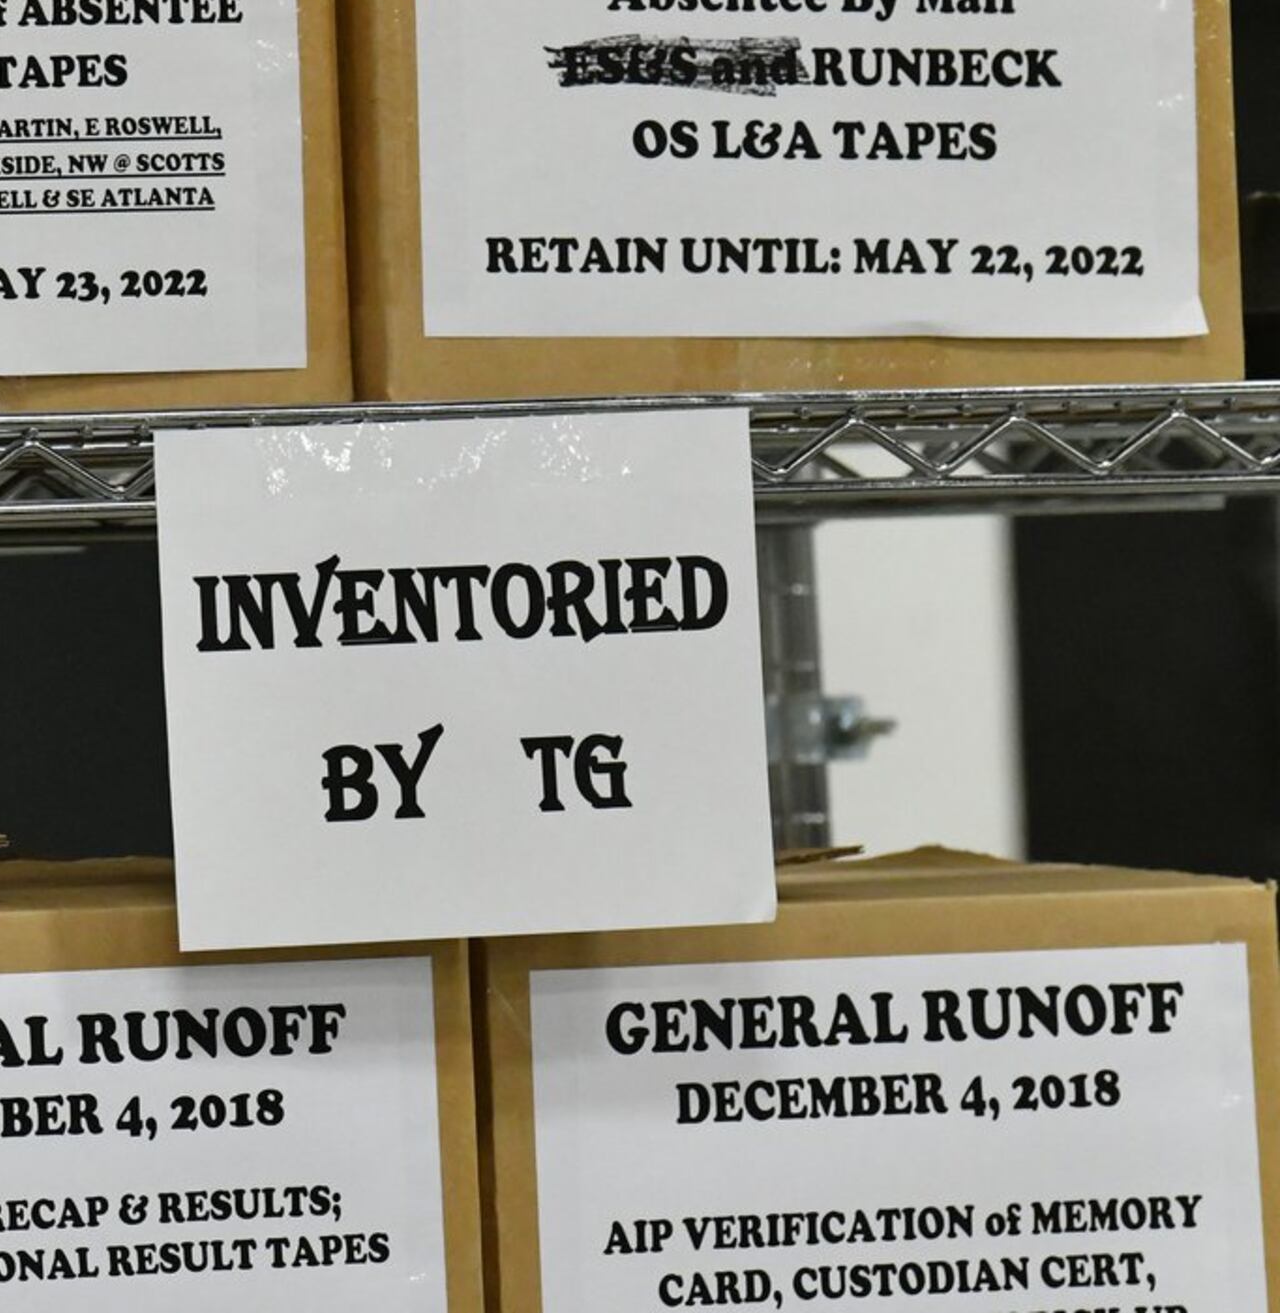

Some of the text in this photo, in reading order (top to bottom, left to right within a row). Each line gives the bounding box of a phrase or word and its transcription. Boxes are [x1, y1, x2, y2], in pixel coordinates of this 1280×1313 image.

[812, 47, 1062, 88] RUNBECK
[85, 118, 100, 136] E
[105, 115, 222, 137] ROSWELL,
[633, 120, 996, 160] OS L&A TAPES
[67, 154, 108, 174] NW
[113, 153, 131, 174] @
[135, 152, 226, 173] SCOTTS
[42, 189, 61, 209] &
[66, 189, 96, 208] SE
[101, 187, 215, 208] ATLANTA
[486, 237, 1143, 282] RETAIN UNTIL: MAY 22, 2022
[193, 555, 728, 652] INVENTORIED
[322, 724, 632, 822] BY TG
[77, 1003, 346, 1064] RUNOFF
[116, 1096, 157, 1140] 4,
[171, 1089, 284, 1131] 2018
[119, 1194, 148, 1225] &
[158, 1185, 341, 1223] RESULTS;
[604, 1195, 1202, 1255] AIP VERIFICATION of MEMORY
[107, 1239, 257, 1276] RESULT
[265, 1233, 389, 1268] TAPES
[659, 1253, 1155, 1309] CARD, CUSTODIAN CERT,
